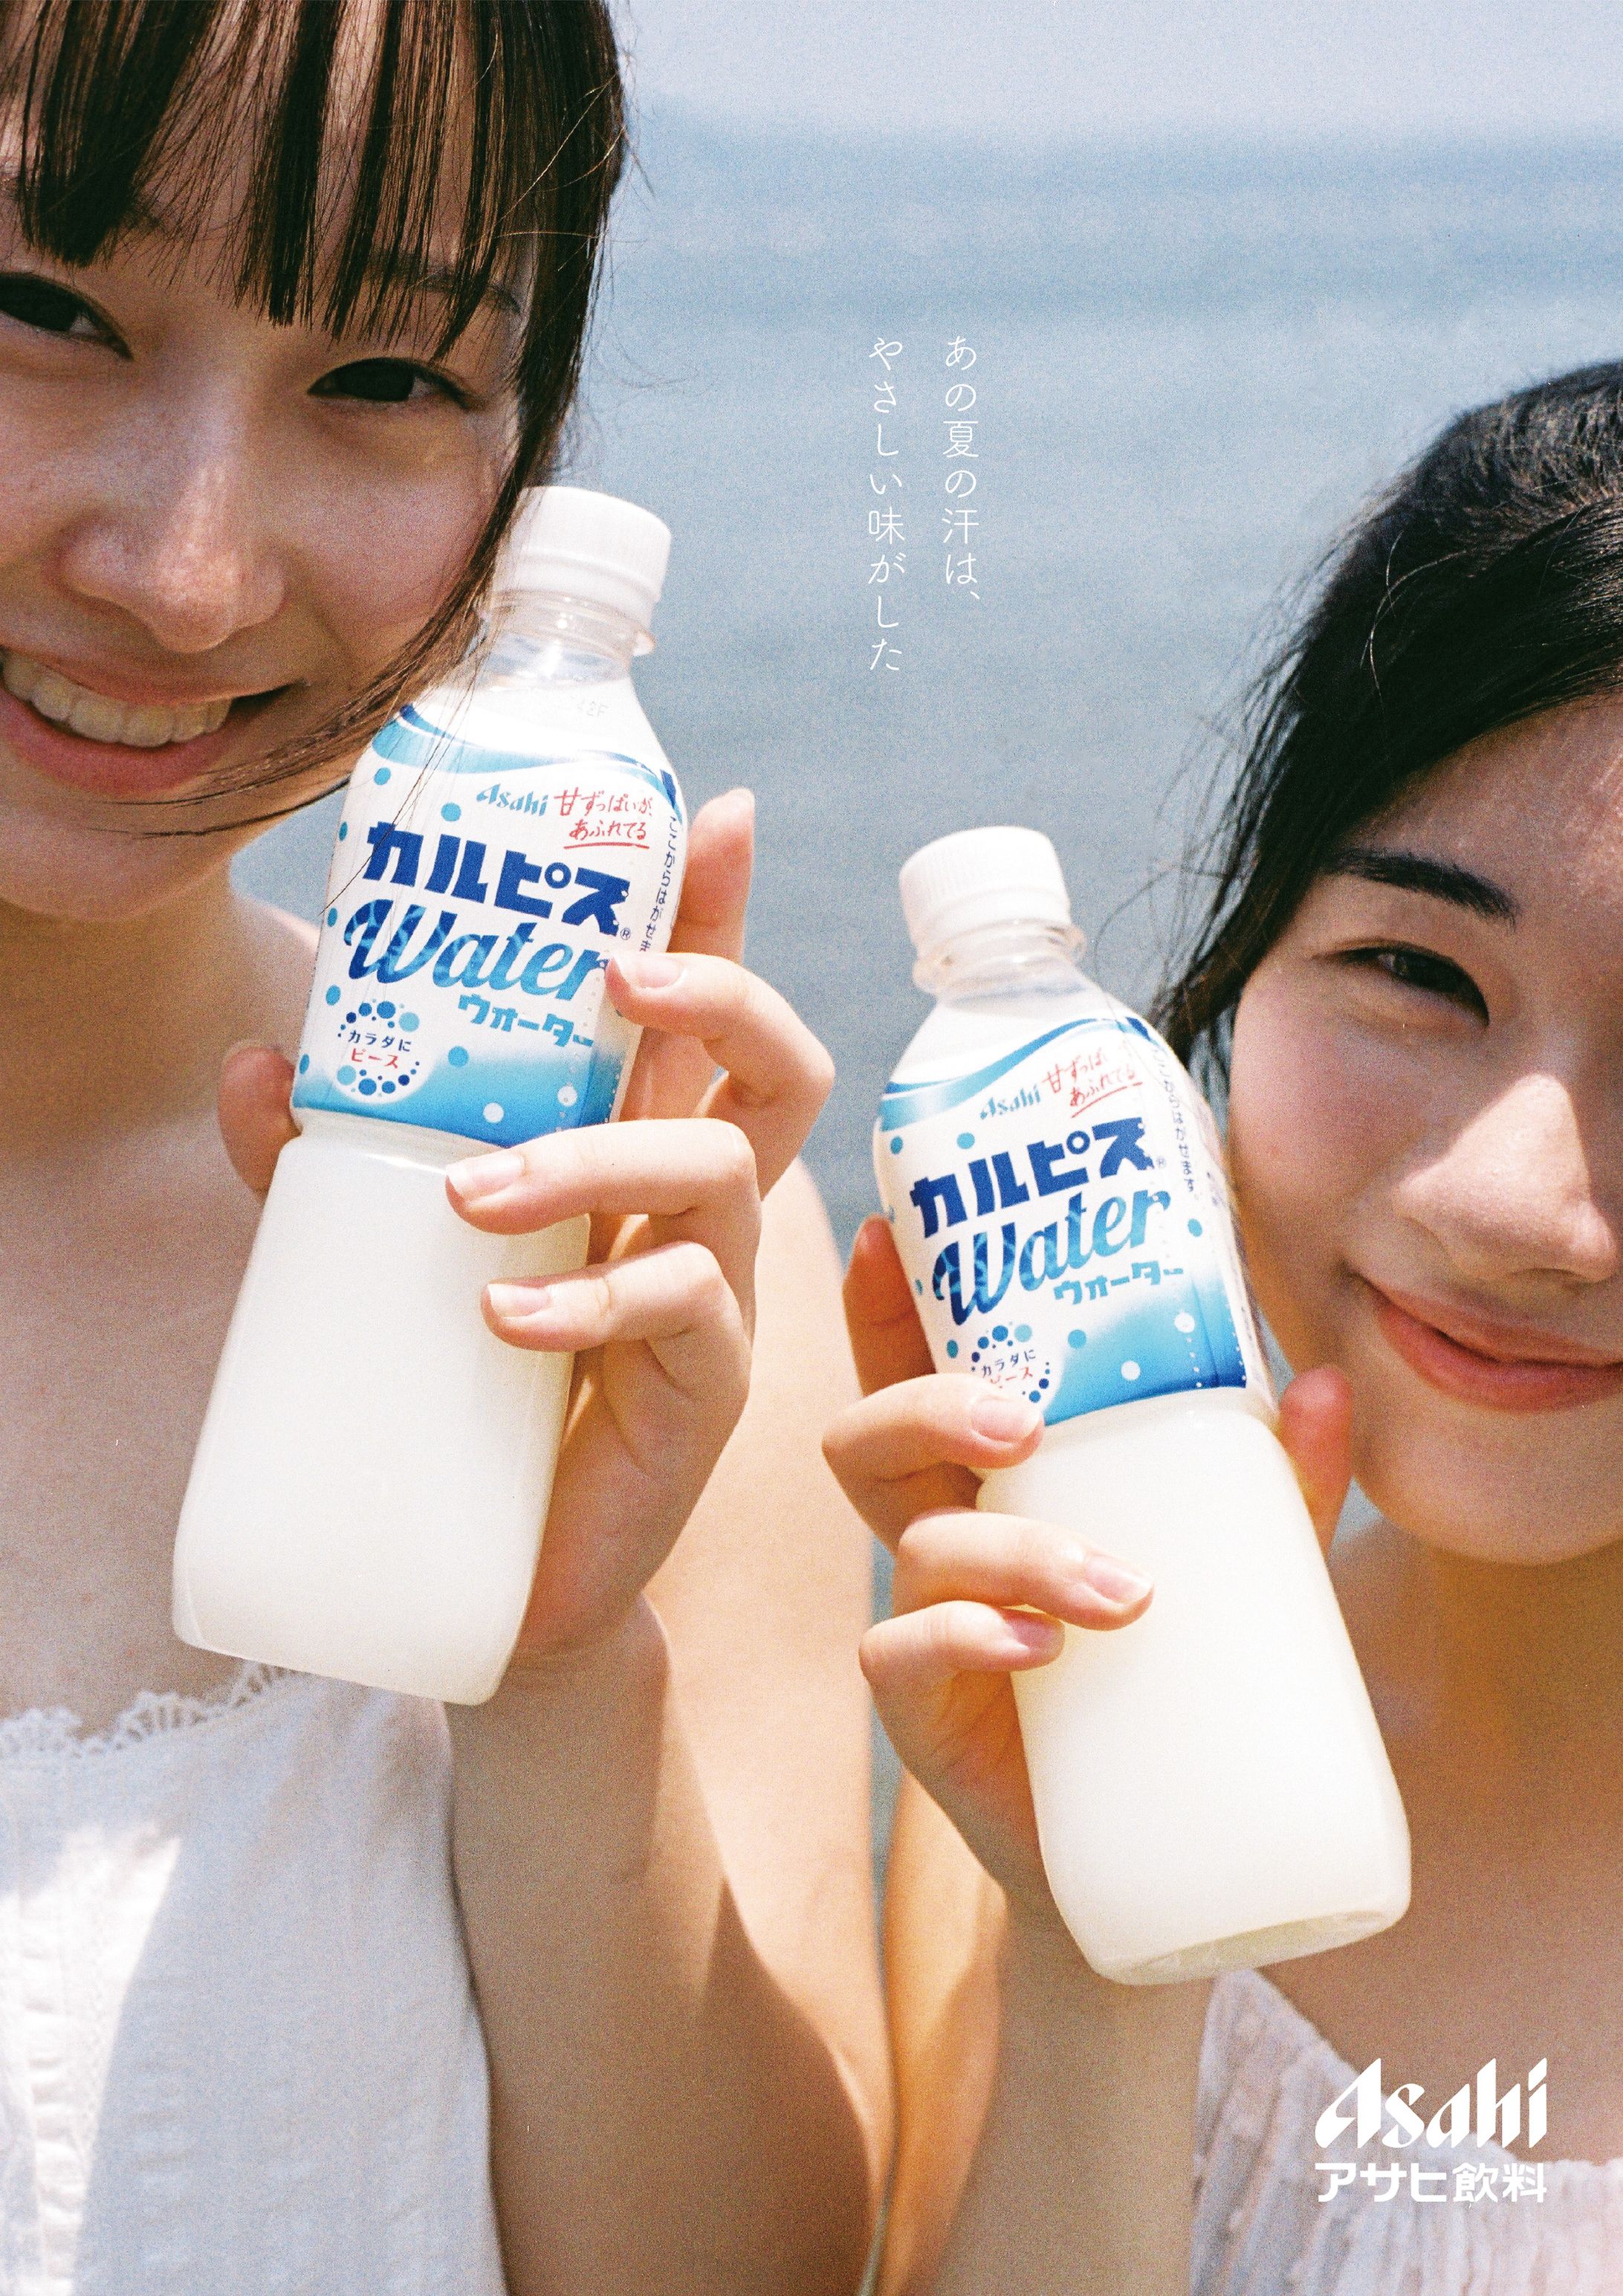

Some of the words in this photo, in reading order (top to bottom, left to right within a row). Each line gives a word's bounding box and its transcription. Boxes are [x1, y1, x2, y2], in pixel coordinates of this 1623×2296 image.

[476, 783, 548, 817] Asahi
[568, 818, 647, 841] あふれてる
[343, 899, 609, 1002] Water
[348, 1029, 412, 1052] カラダに
[352, 1048, 398, 1069] ピース
[979, 1083, 1040, 1120] Asahi
[933, 1189, 1171, 1326] Water
[982, 1349, 1036, 1378] カラダに
